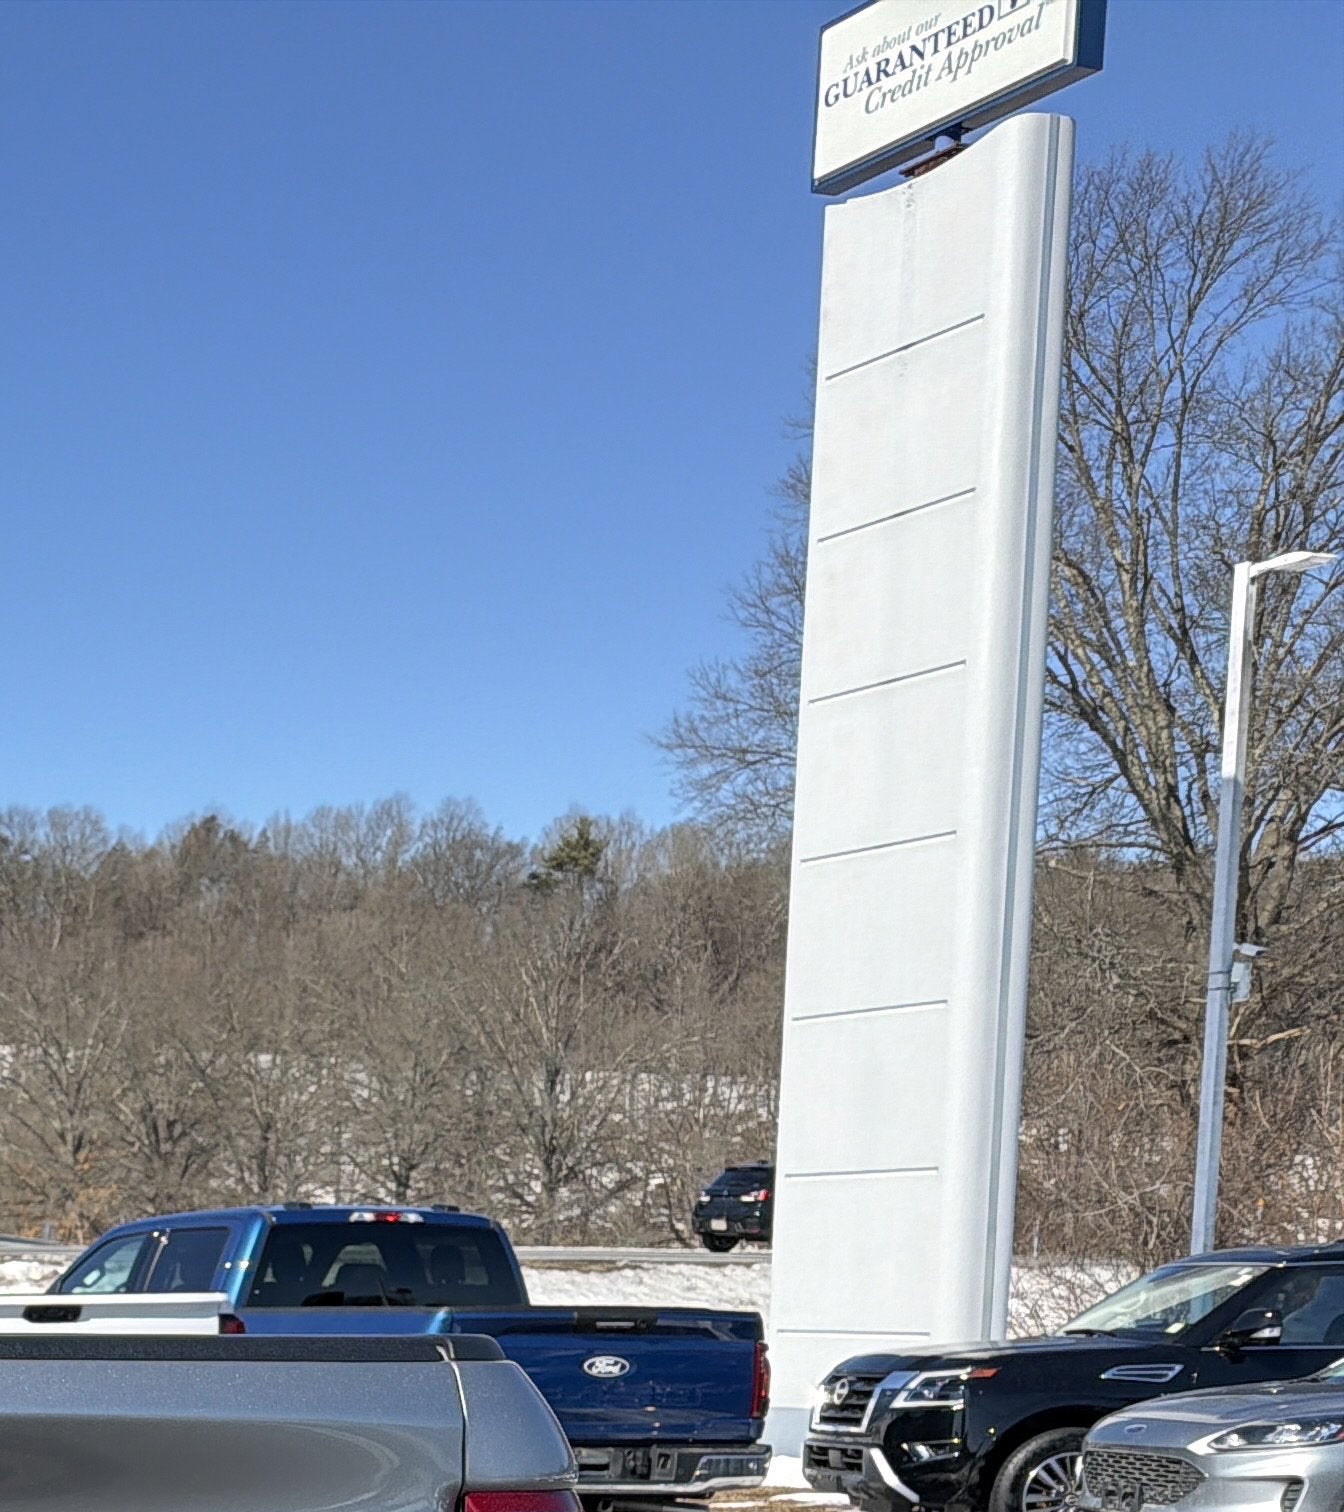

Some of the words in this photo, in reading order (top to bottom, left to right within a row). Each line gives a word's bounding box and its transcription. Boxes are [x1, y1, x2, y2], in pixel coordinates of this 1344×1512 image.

[824, 4, 995, 108] GUARANTEED
[842, 46, 869, 74] Ask
[872, 26, 912, 58] about
[915, 12, 942, 36] our
[864, 63, 932, 114] Credit
[935, 2, 1045, 83] Approval
